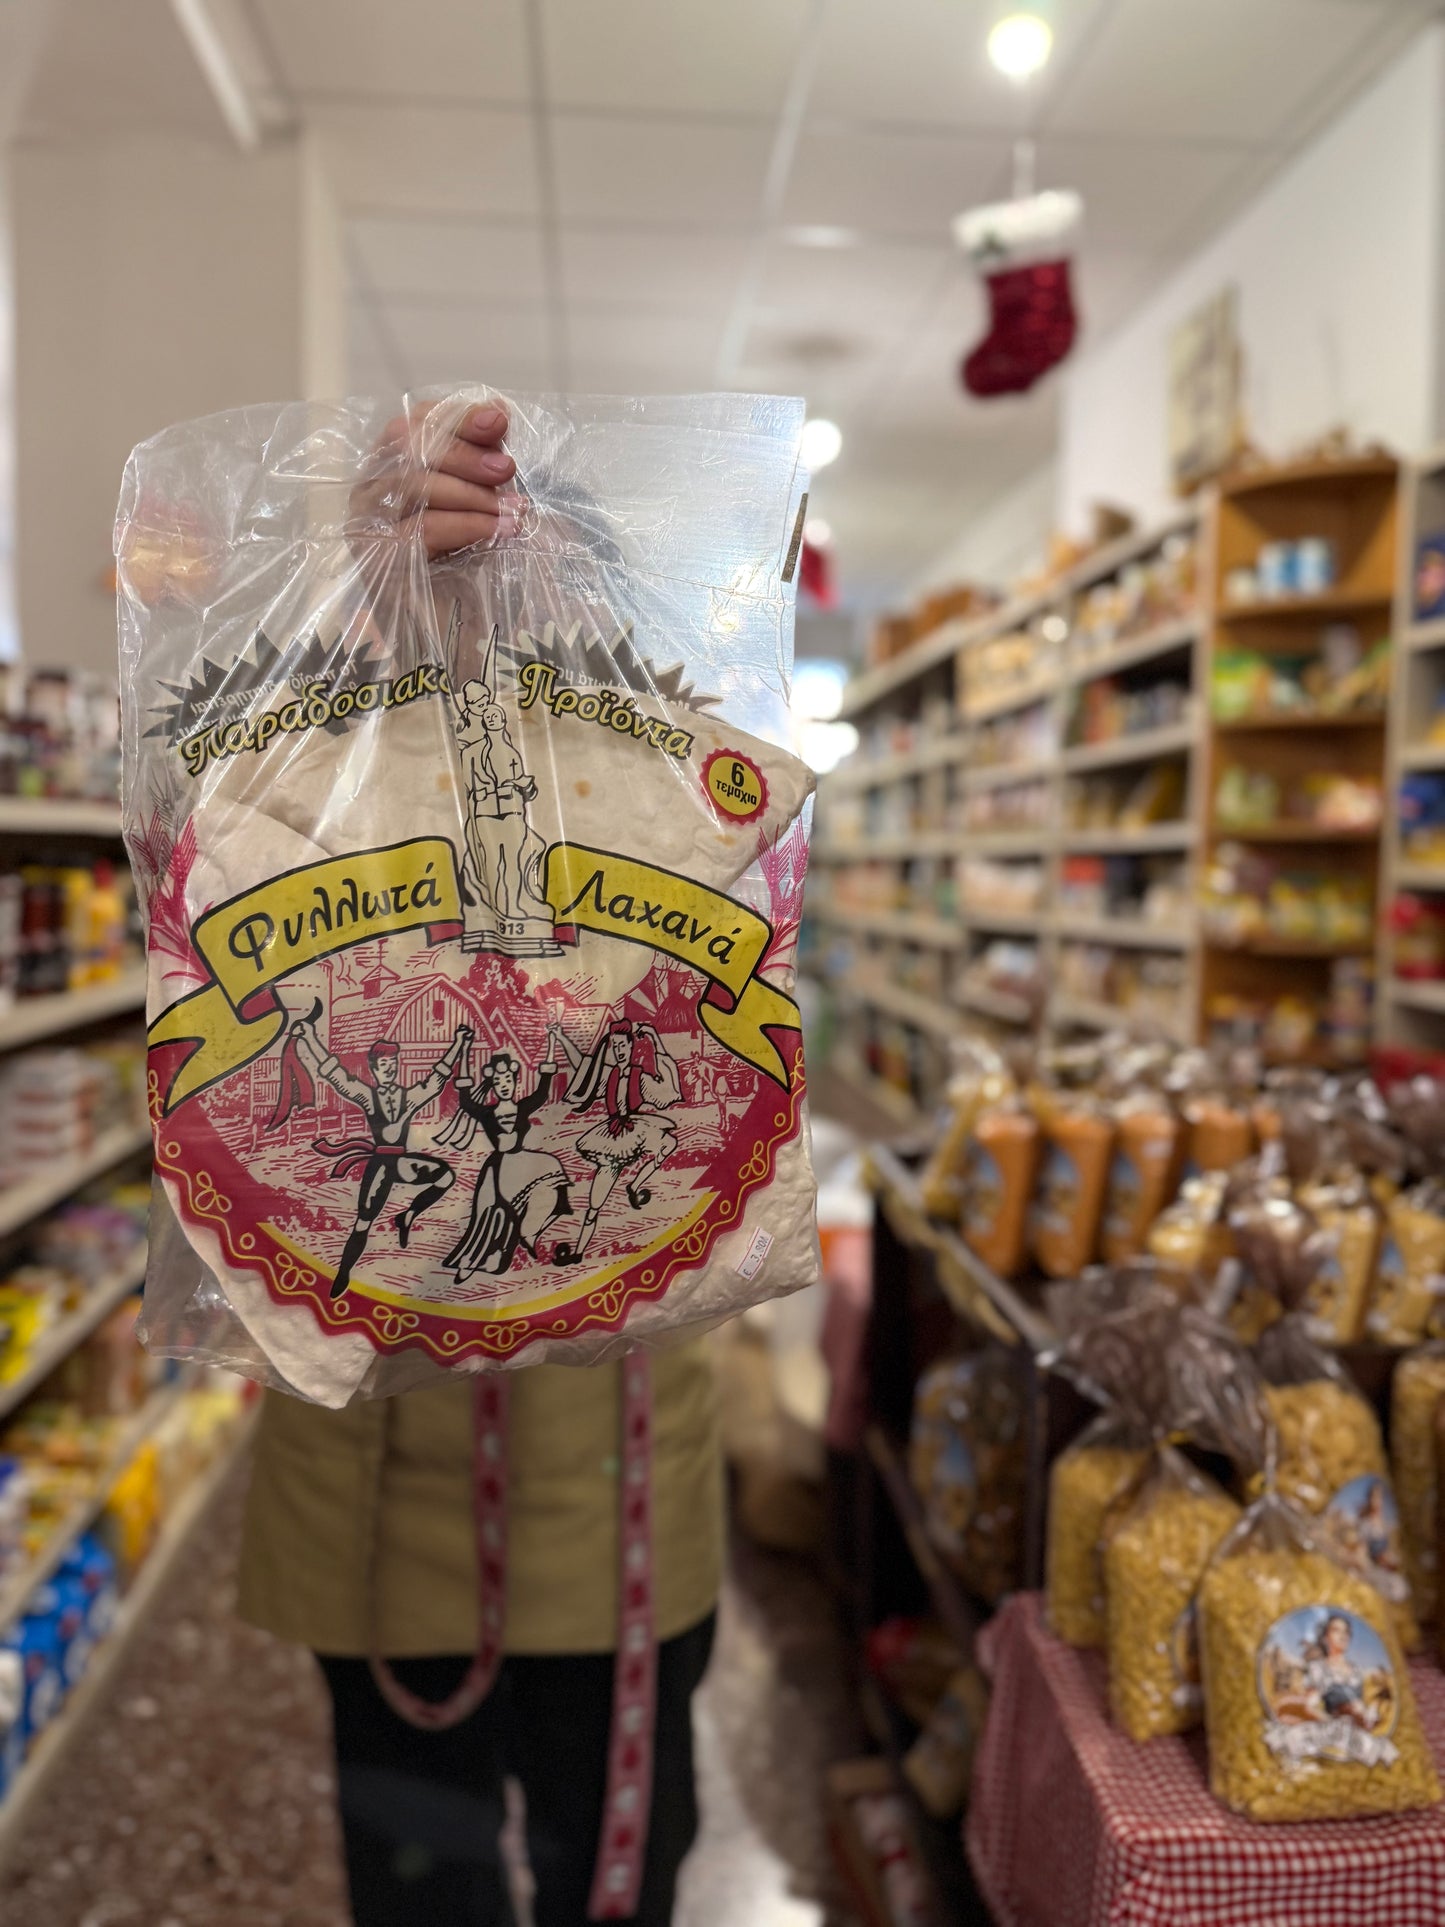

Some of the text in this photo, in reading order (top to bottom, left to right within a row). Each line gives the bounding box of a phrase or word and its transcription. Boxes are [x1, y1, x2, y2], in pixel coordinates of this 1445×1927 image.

[517, 660, 696, 760] Προϊόντα
[715, 779, 758, 807] τεμαχια
[730, 761, 746, 788] 6
[227, 861, 741, 973] Φυλλωτά Λαχανά
